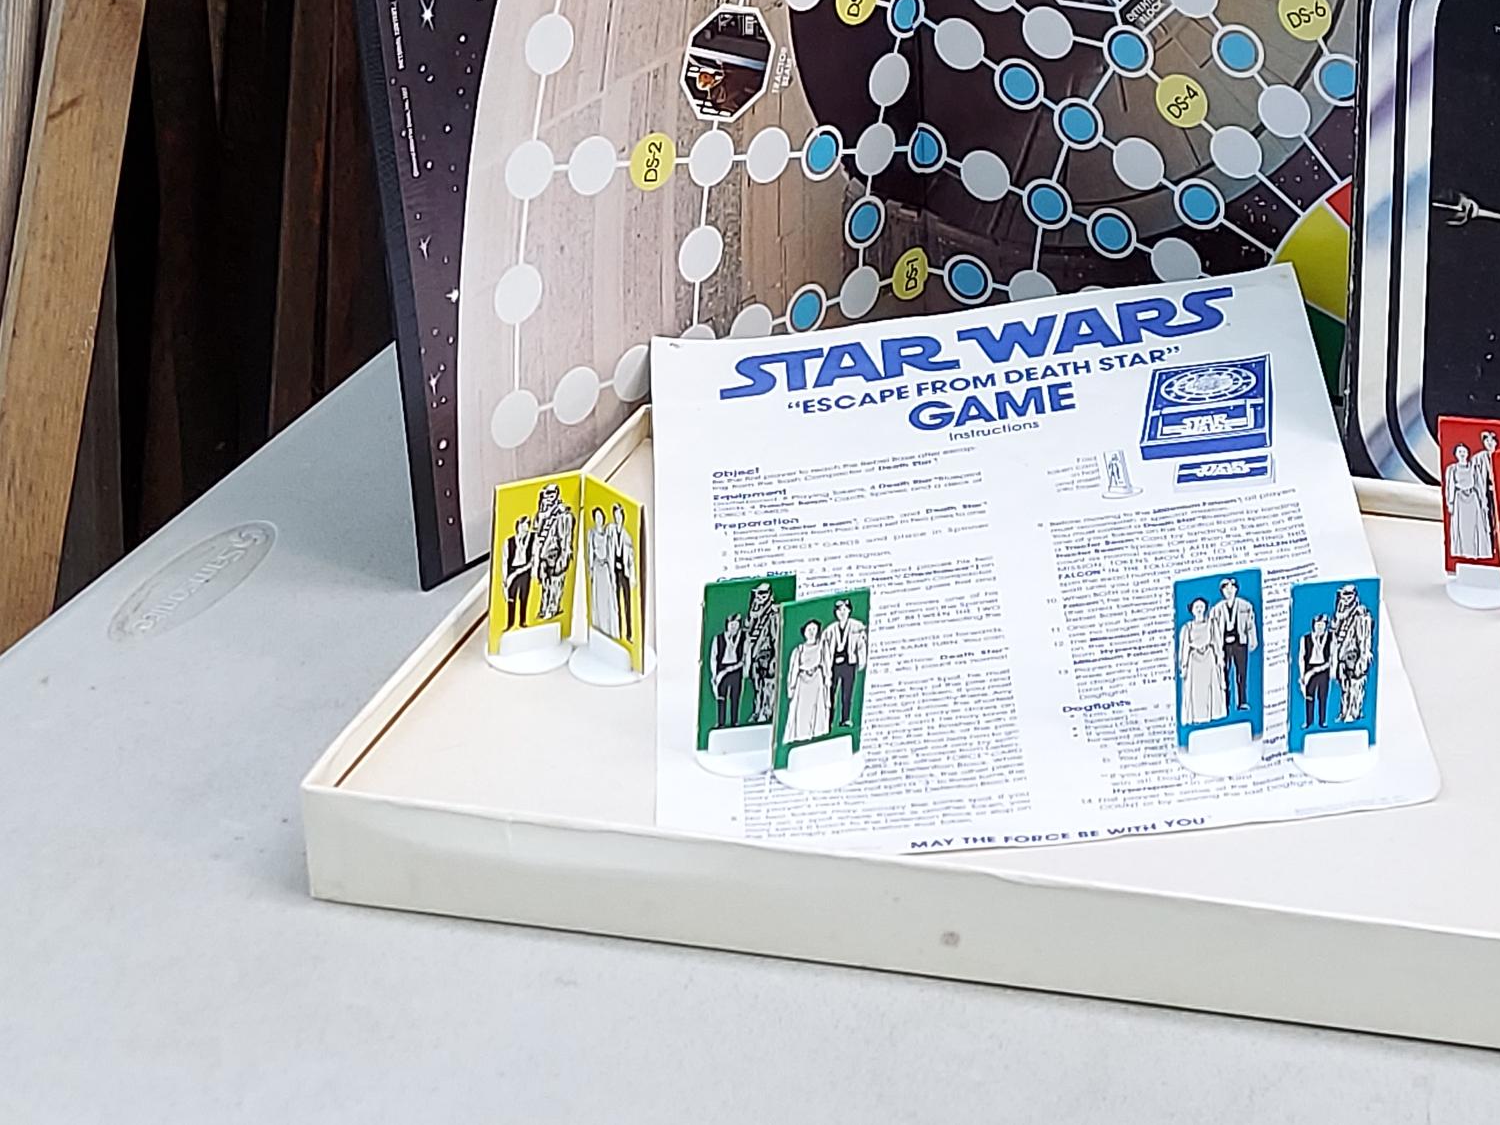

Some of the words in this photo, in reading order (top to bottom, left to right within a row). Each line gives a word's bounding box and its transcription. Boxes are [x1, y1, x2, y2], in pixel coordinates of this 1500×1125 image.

[1286, 0, 1327, 29] DS-6
[1166, 84, 1199, 119] DS-4
[643, 141, 662, 182] DS-2
[904, 257, 919, 291] DS-1
[719, 336, 960, 401] STAR
[957, 286, 1234, 359] WARS
[787, 385, 910, 415] “ESCAPE
[916, 373, 997, 396] FROM
[1004, 359, 1091, 384] DEATH
[1098, 345, 1181, 373] STAR”
[908, 381, 1077, 433] GAME
[948, 420, 1041, 443] Instructions
[712, 466, 760, 479] Object
[713, 488, 788, 502] Equipment
[713, 517, 800, 531] Preparation
[1062, 699, 1132, 714] Dogfights
[910, 837, 954, 850] MAY
[962, 835, 997, 845] THE
[1003, 831, 1071, 844] FORCE
[1078, 829, 1100, 839] BE
[1107, 822, 1157, 836] WITH
[1164, 817, 1205, 829] YOU
